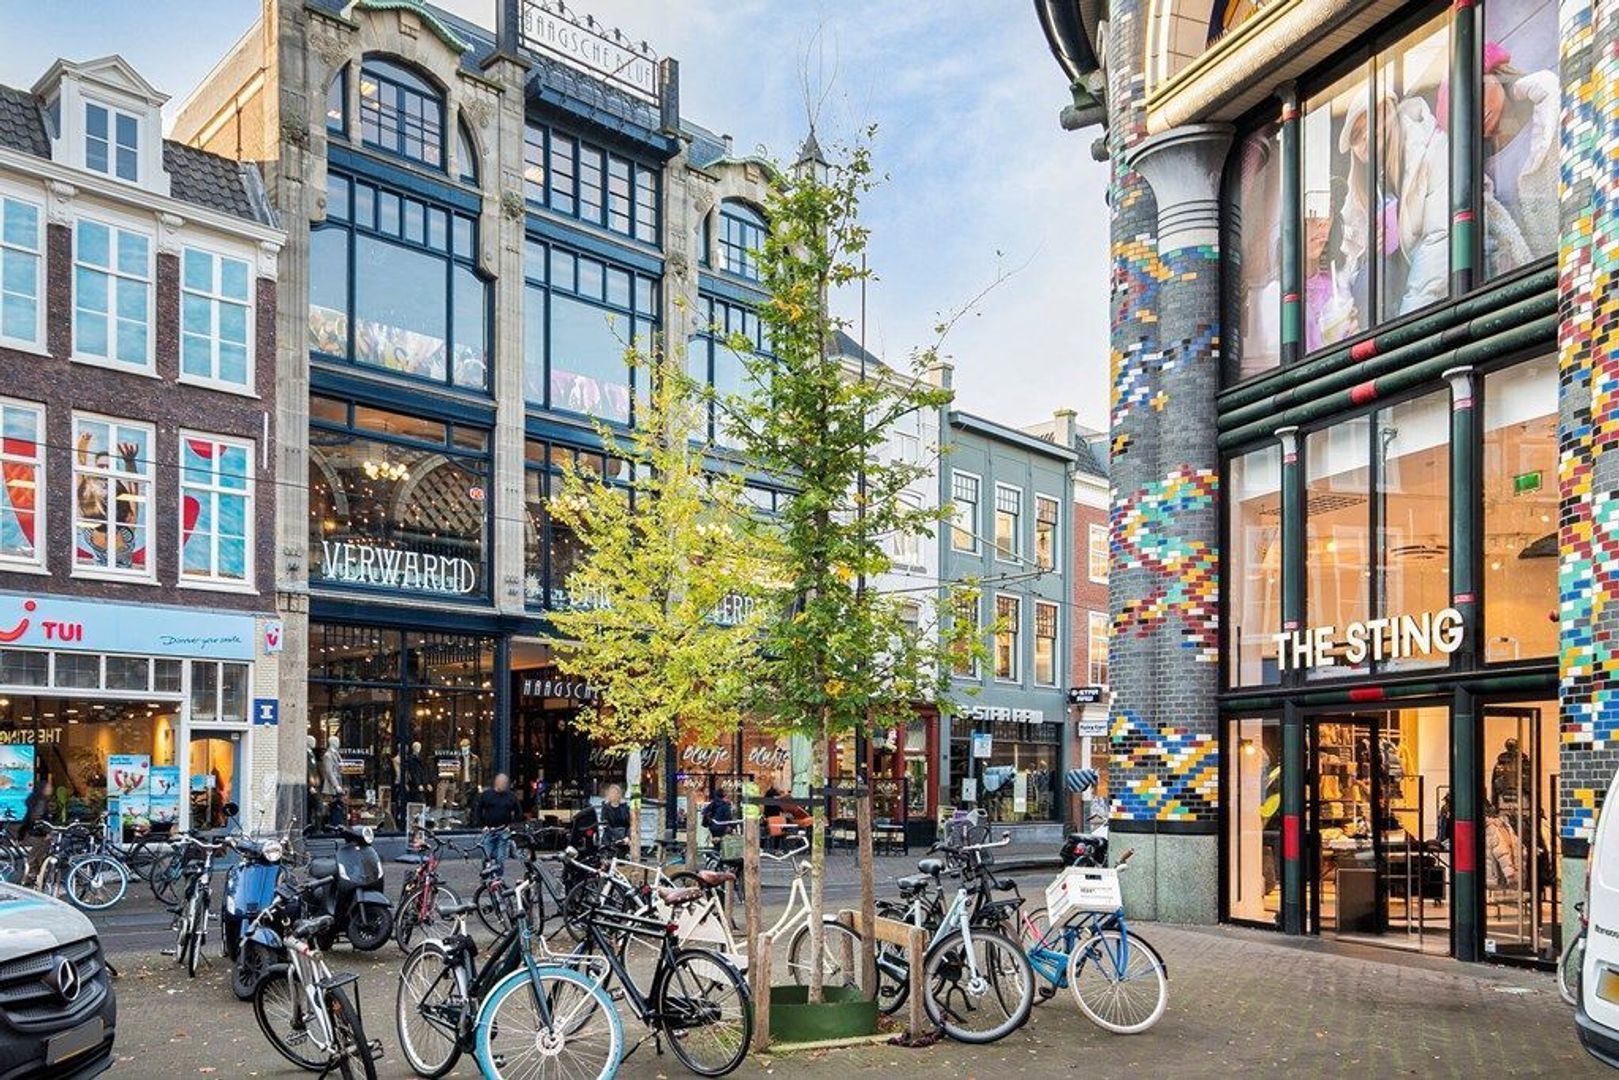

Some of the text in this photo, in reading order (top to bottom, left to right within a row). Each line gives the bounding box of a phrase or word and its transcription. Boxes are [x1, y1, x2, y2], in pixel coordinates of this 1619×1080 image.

[321, 540, 476, 593] VERWARMD
[42, 621, 83, 641] TUI
[1272, 607, 1465, 671] THE STING
[957, 705, 1010, 721] G-STAR
